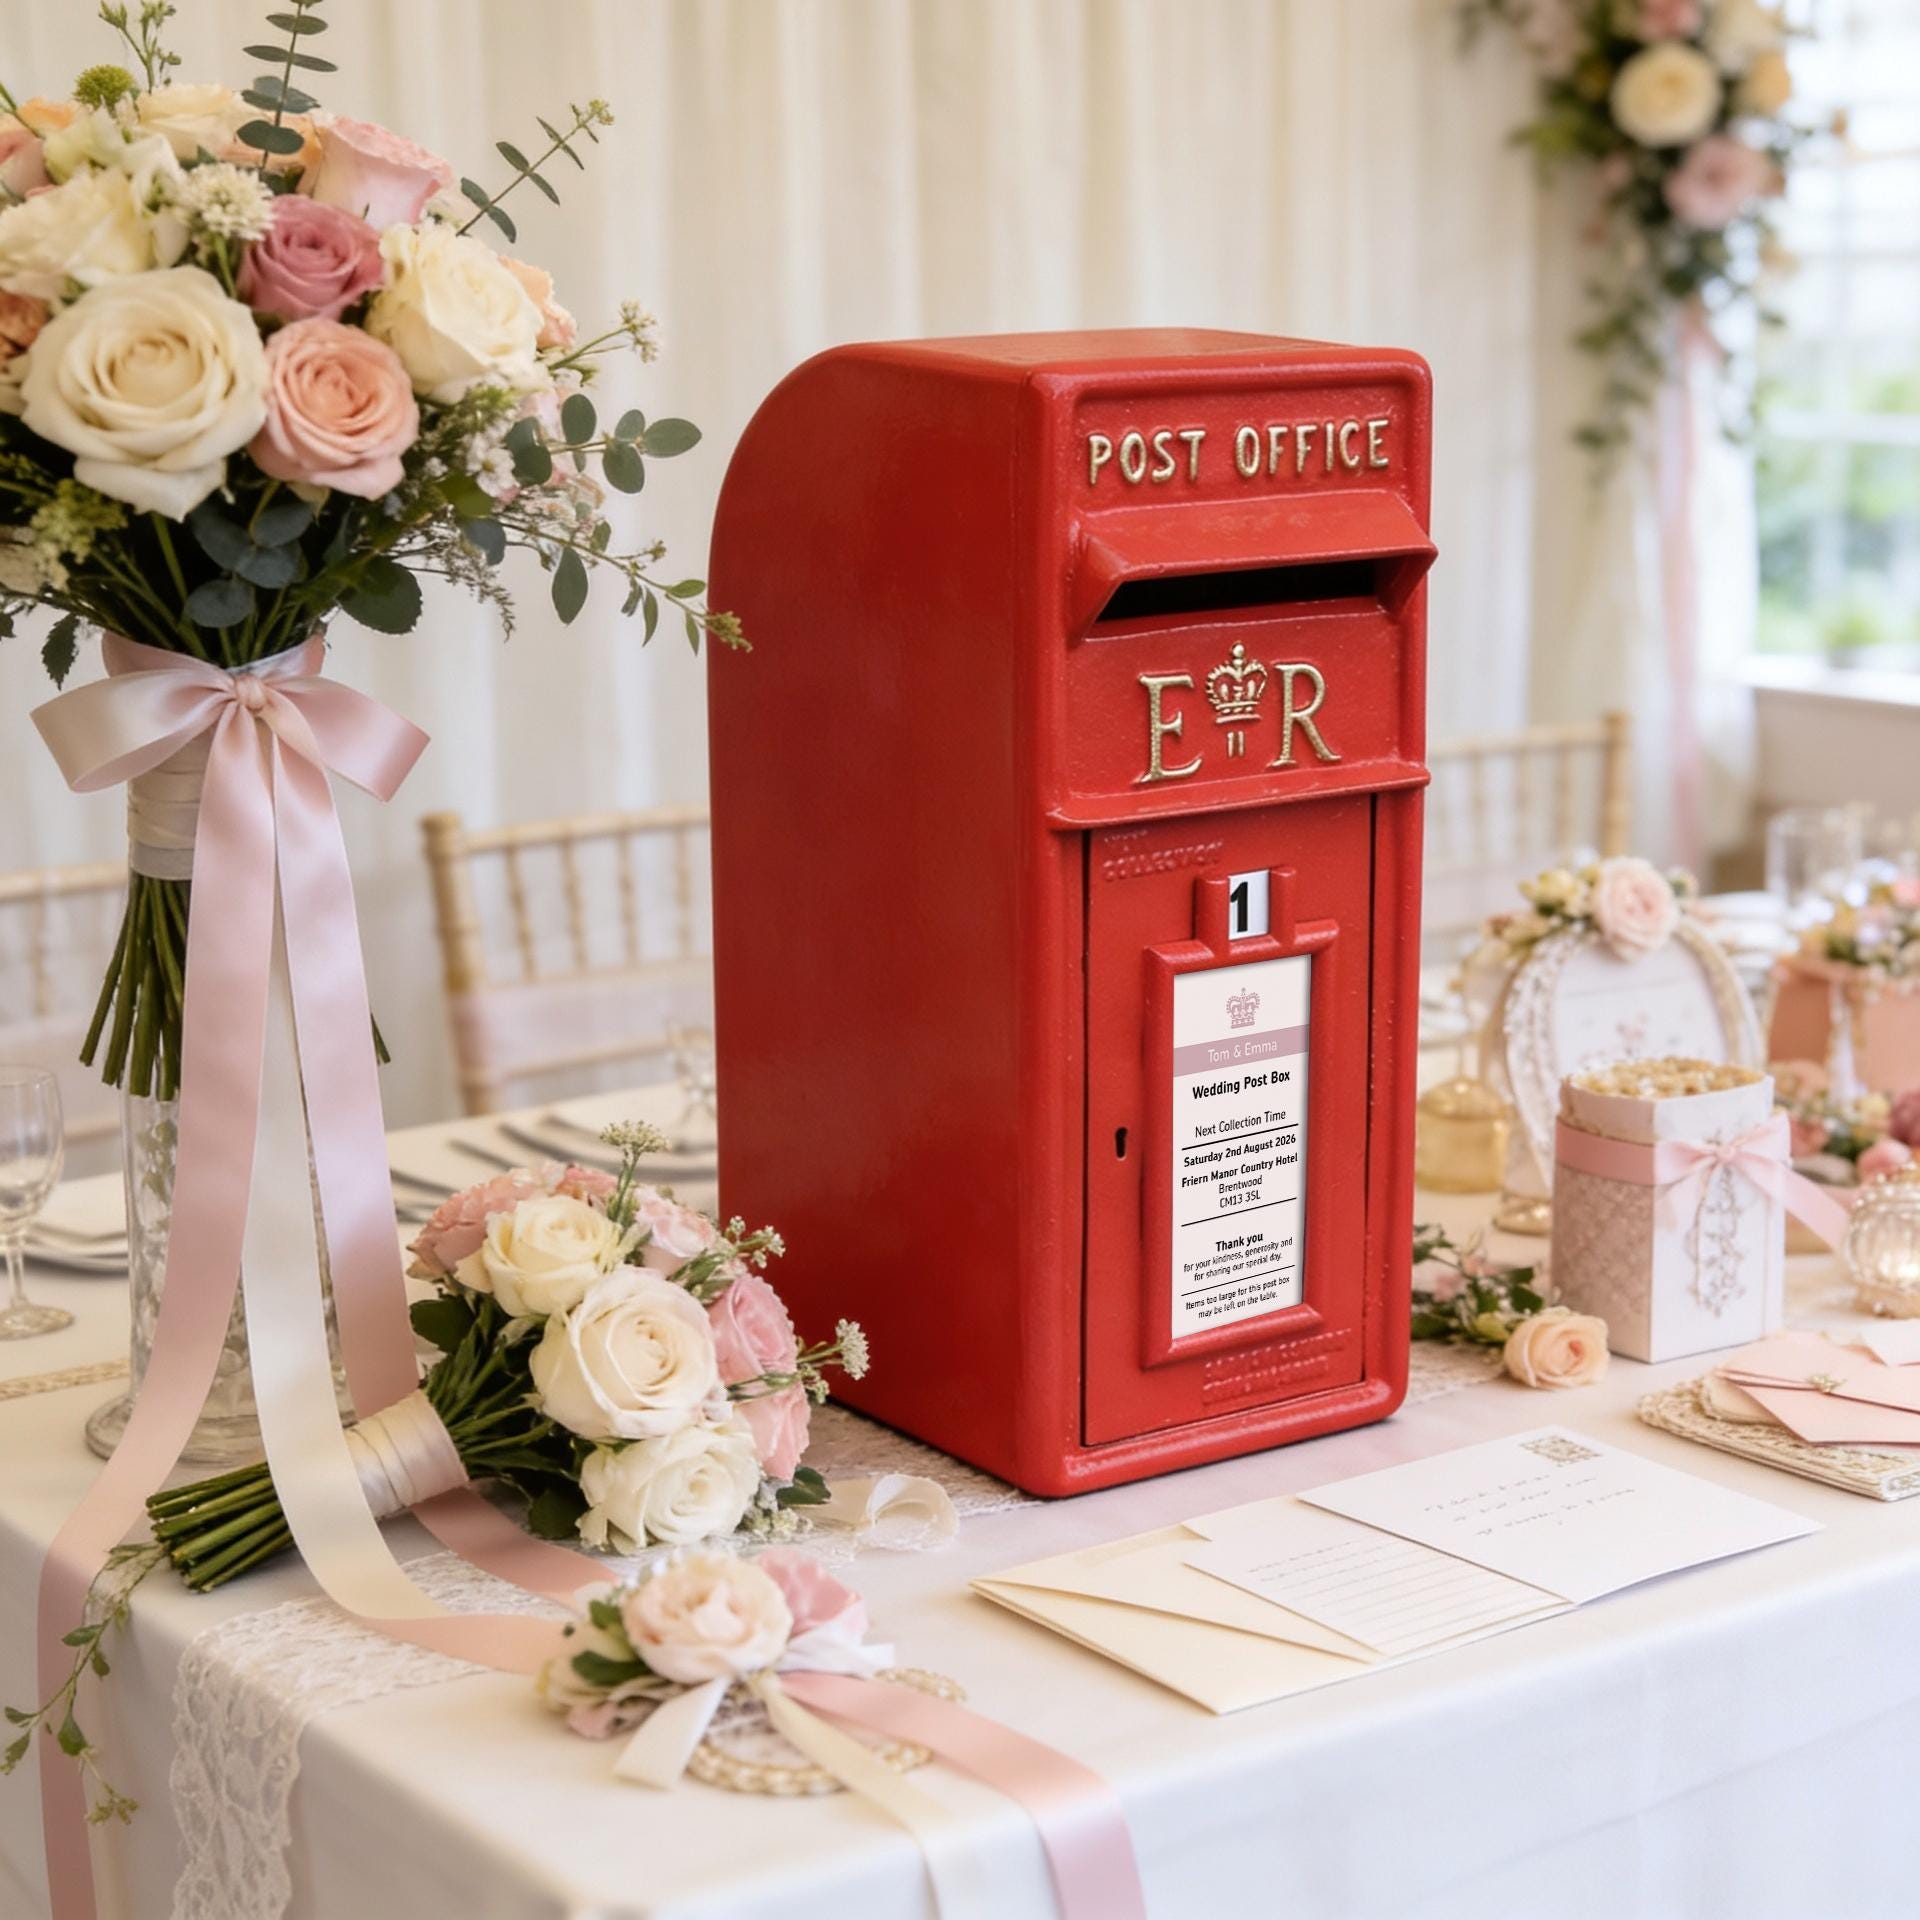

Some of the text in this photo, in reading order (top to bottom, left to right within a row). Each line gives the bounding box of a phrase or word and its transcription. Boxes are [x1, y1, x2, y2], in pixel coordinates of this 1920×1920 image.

[1088, 419, 1389, 485] POST OFFICE
[1132, 662, 1342, 784] E R
[1230, 881, 1248, 932] 1
[1208, 1040, 1278, 1063] Tom & Emma
[1192, 1070, 1291, 1100] Wedding Post Box
[1195, 1110, 1286, 1138] Next Collection Time
[1184, 1134, 1297, 1168] Saturday 2nd August 2026
[1181, 1152, 1298, 1188] Friern Manor Country Hotel
[1219, 1175, 1263, 1194] Brentwood
[1220, 1194, 1243, 1209] CM13
[1184, 1237, 1293, 1272] for your kindness, generosity and
[1216, 1233, 1264, 1252] Thank you
[1194, 1273, 1205, 1281] for
[1206, 1266, 1231, 1279] sharing
[1232, 1262, 1245, 1271] our
[1246, 1255, 1268, 1268] special
[1186, 1276, 1290, 1310] Items too large for this post box
[1199, 1309, 1213, 1318] may
[1214, 1305, 1223, 1315] be
[1224, 1300, 1236, 1312] left
[1237, 1300, 1246, 1308] on
[1247, 1296, 1259, 1305] the
